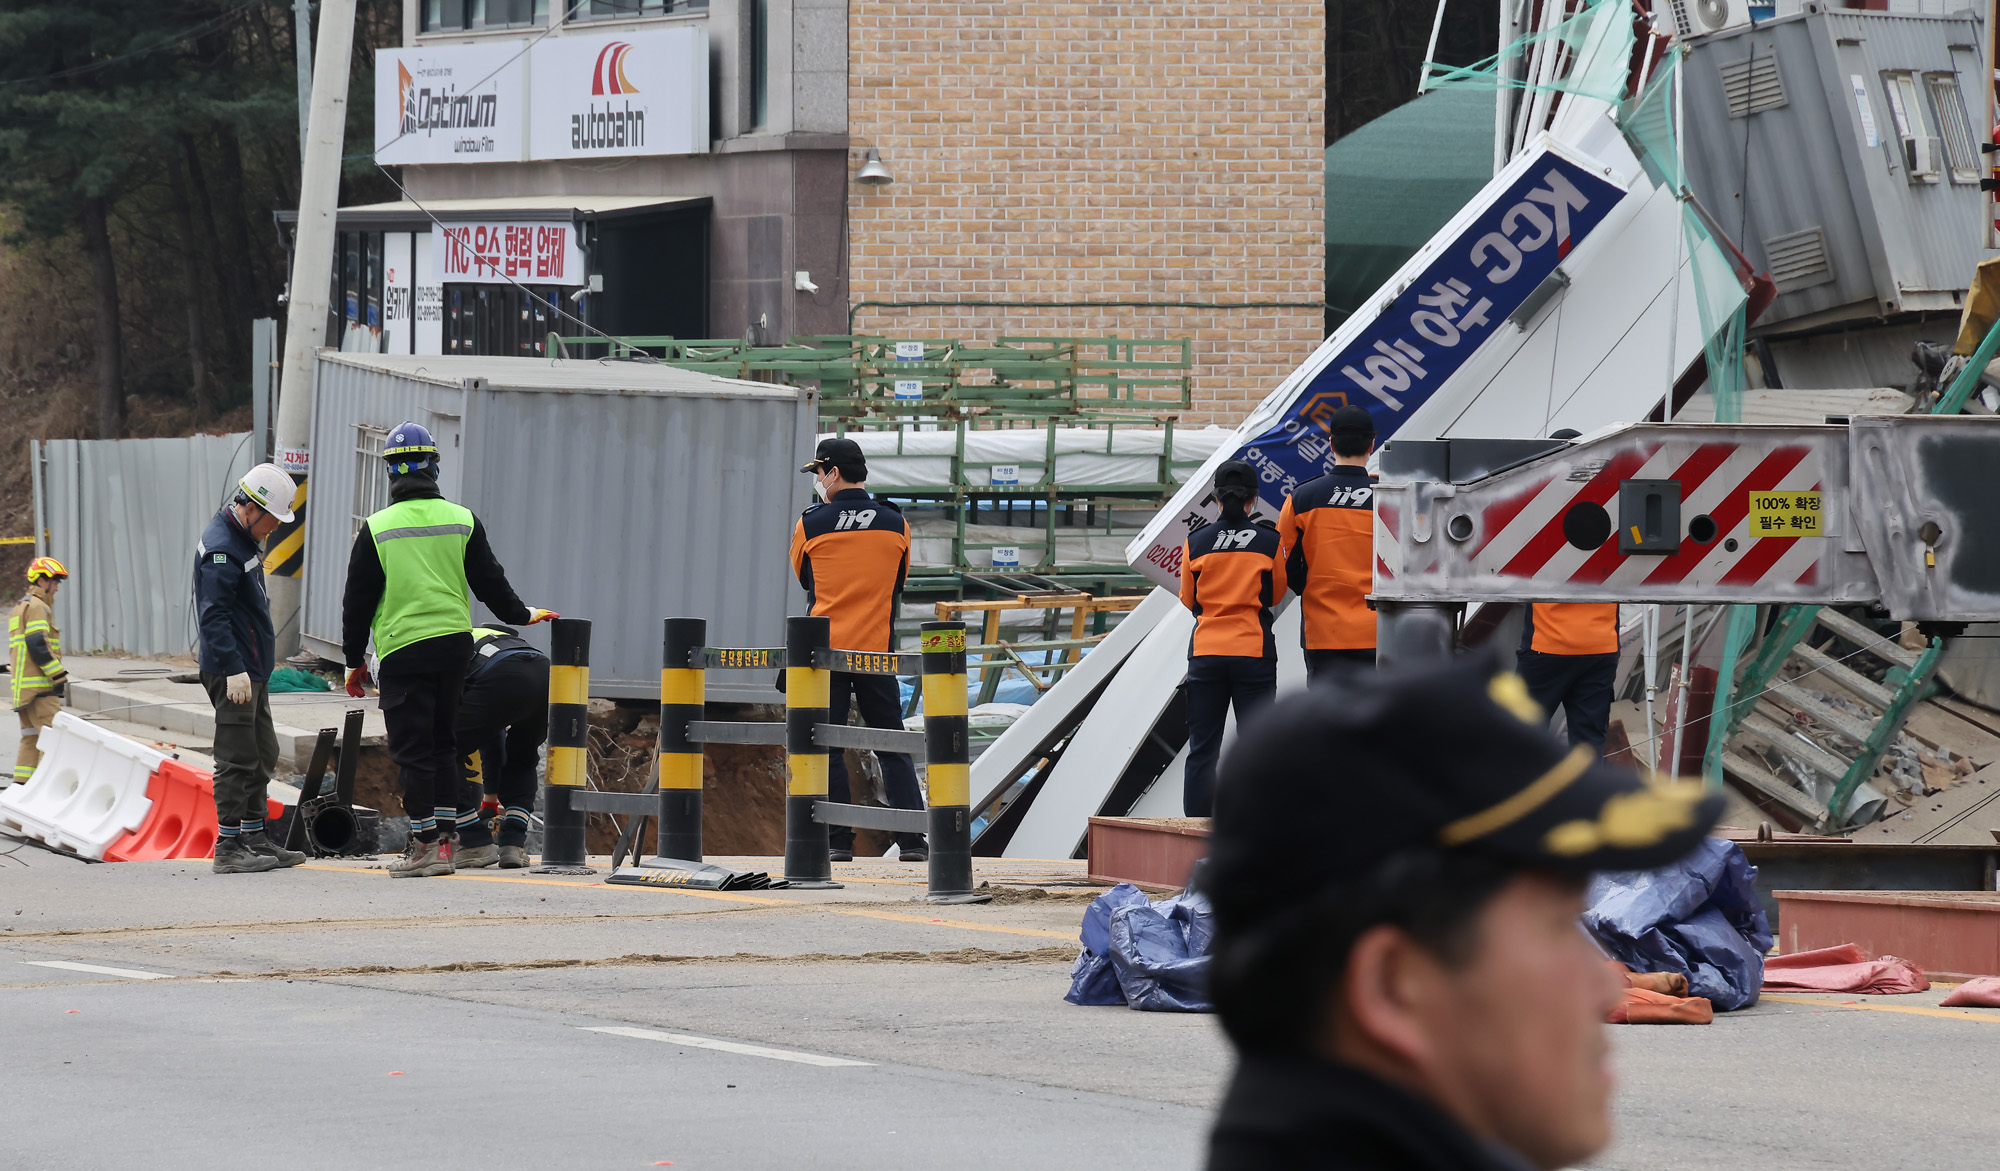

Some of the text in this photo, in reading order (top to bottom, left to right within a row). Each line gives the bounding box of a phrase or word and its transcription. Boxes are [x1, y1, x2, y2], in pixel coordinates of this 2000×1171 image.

[417, 83, 497, 138] Optimum
[572, 100, 644, 149] autobahn
[454, 136, 480, 153] window
[1470, 168, 1590, 284] KCC
[443, 225, 566, 278] TKC 우수 협력 업체
[1341, 277, 1494, 412] 창호
[1327, 487, 1373, 507] 119
[1756, 496, 1821, 511] 100% 확장
[834, 509, 877, 530] 119
[1760, 516, 1816, 530] 필수 확인
[1211, 529, 1258, 551] 119
[720, 650, 768, 667] 무단횡단금지
[846, 652, 898, 673] 무단횡단금지
